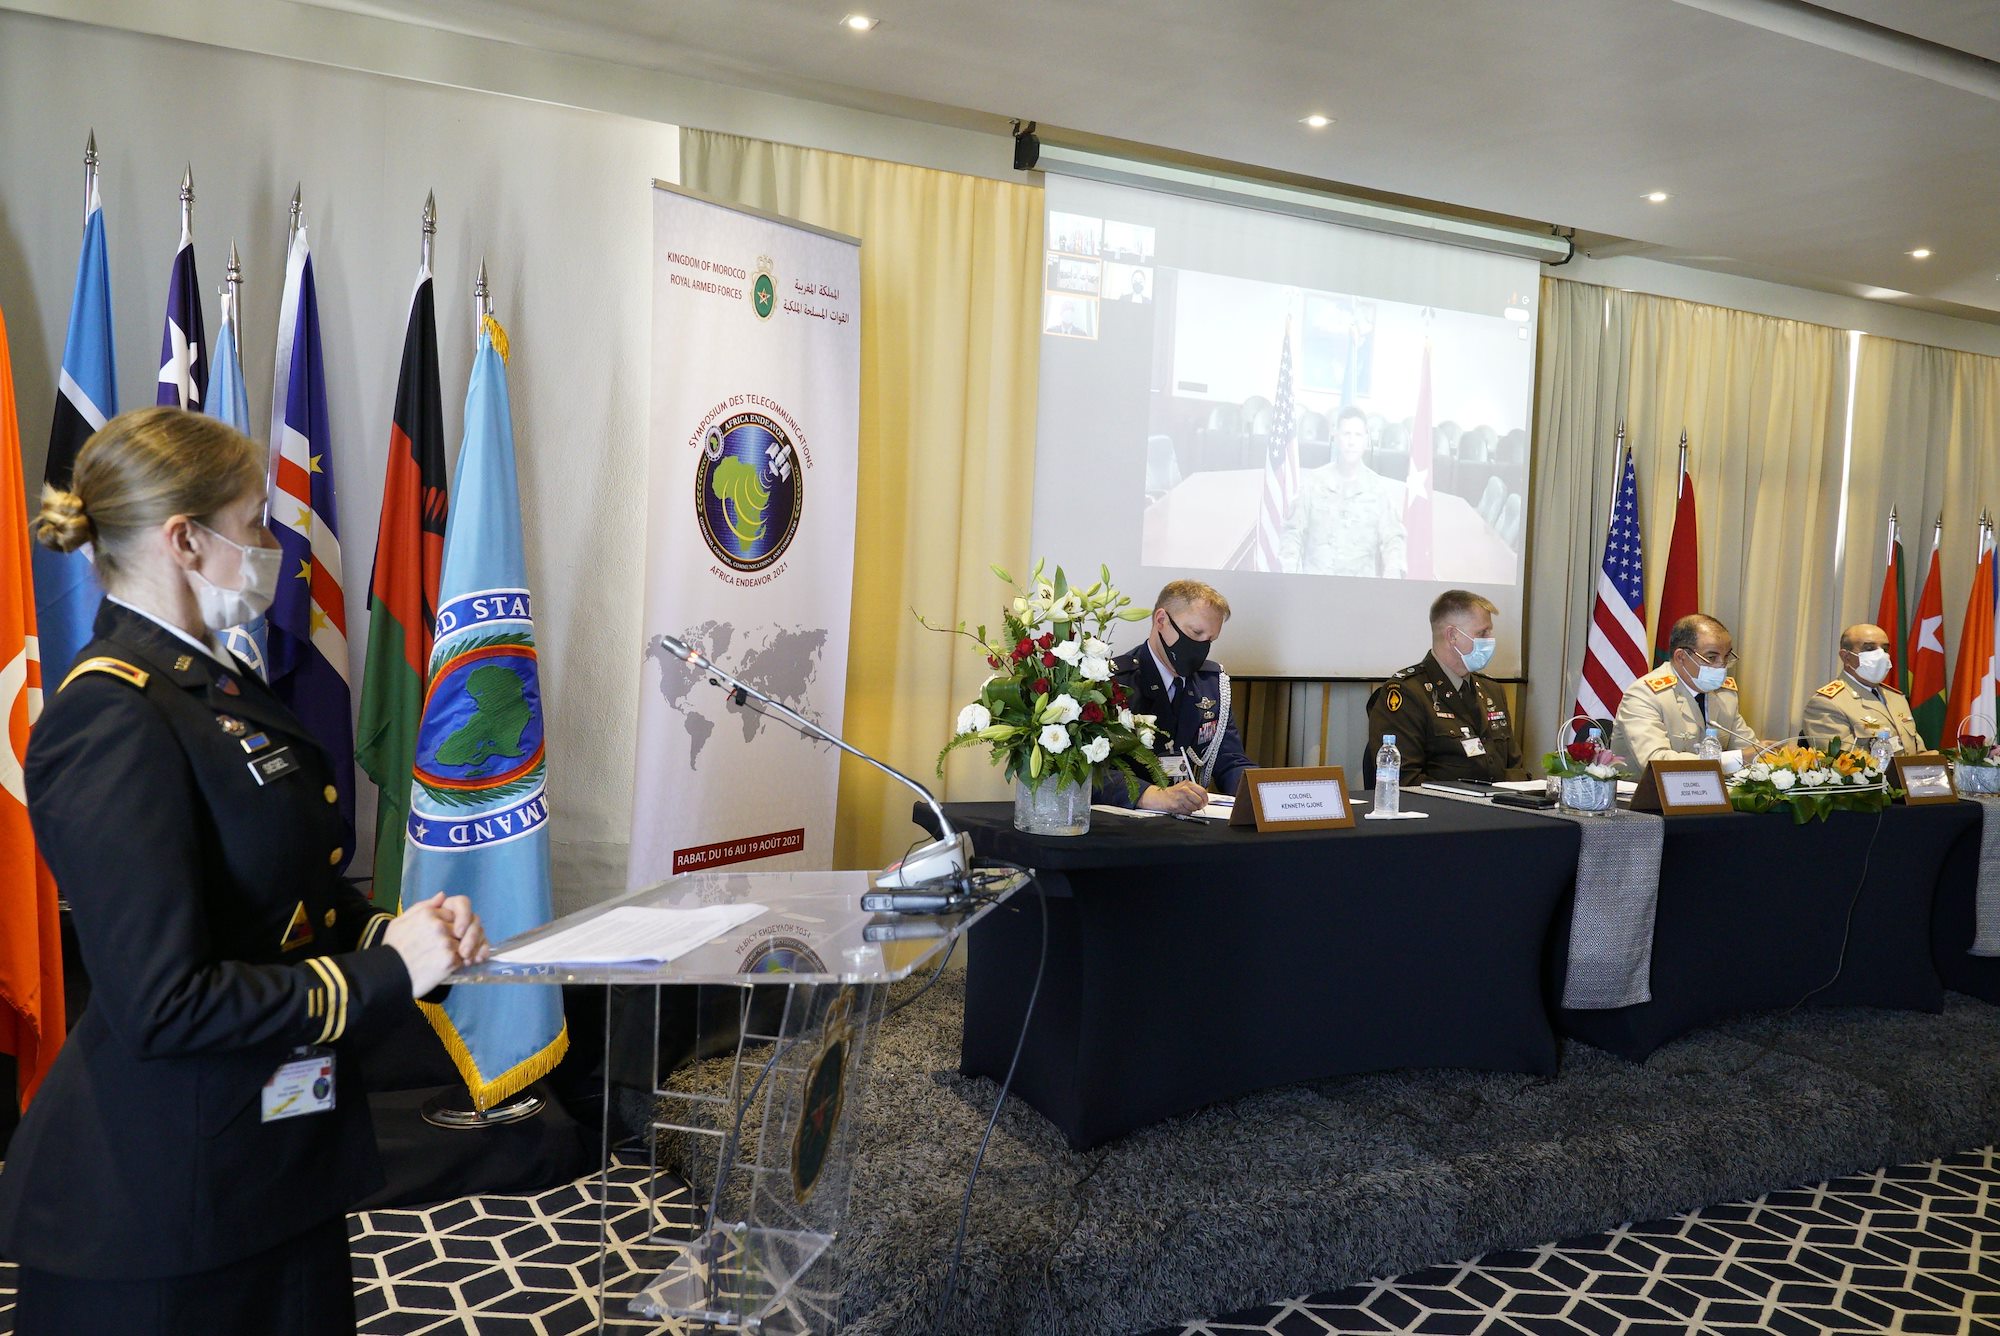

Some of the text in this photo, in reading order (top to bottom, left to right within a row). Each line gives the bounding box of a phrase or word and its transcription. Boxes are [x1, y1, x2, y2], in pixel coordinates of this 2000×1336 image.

[667, 251, 746, 280] KINGDOM OF MOROCCO
[670, 273, 743, 300] ROYAL ARMED FORCES
[794, 278, 840, 300] المملكة المغربية
[783, 299, 850, 325] القوات المسلحة الملكية
[688, 401, 728, 449] SYMPOSIUM
[728, 394, 745, 407] DES
[746, 393, 814, 469] TELECOMMUNICATIONS
[724, 414, 785, 440] AFRICA ENDEAVOR
[780, 520, 797, 552] COMPUTERS
[710, 562, 788, 587] AFRICA ENDEAVOR 2021
[1281, 802, 1305, 810] KENNETH
[677, 834, 800, 866] RABAT, DU 16 AU 19 AOÛT 2021
